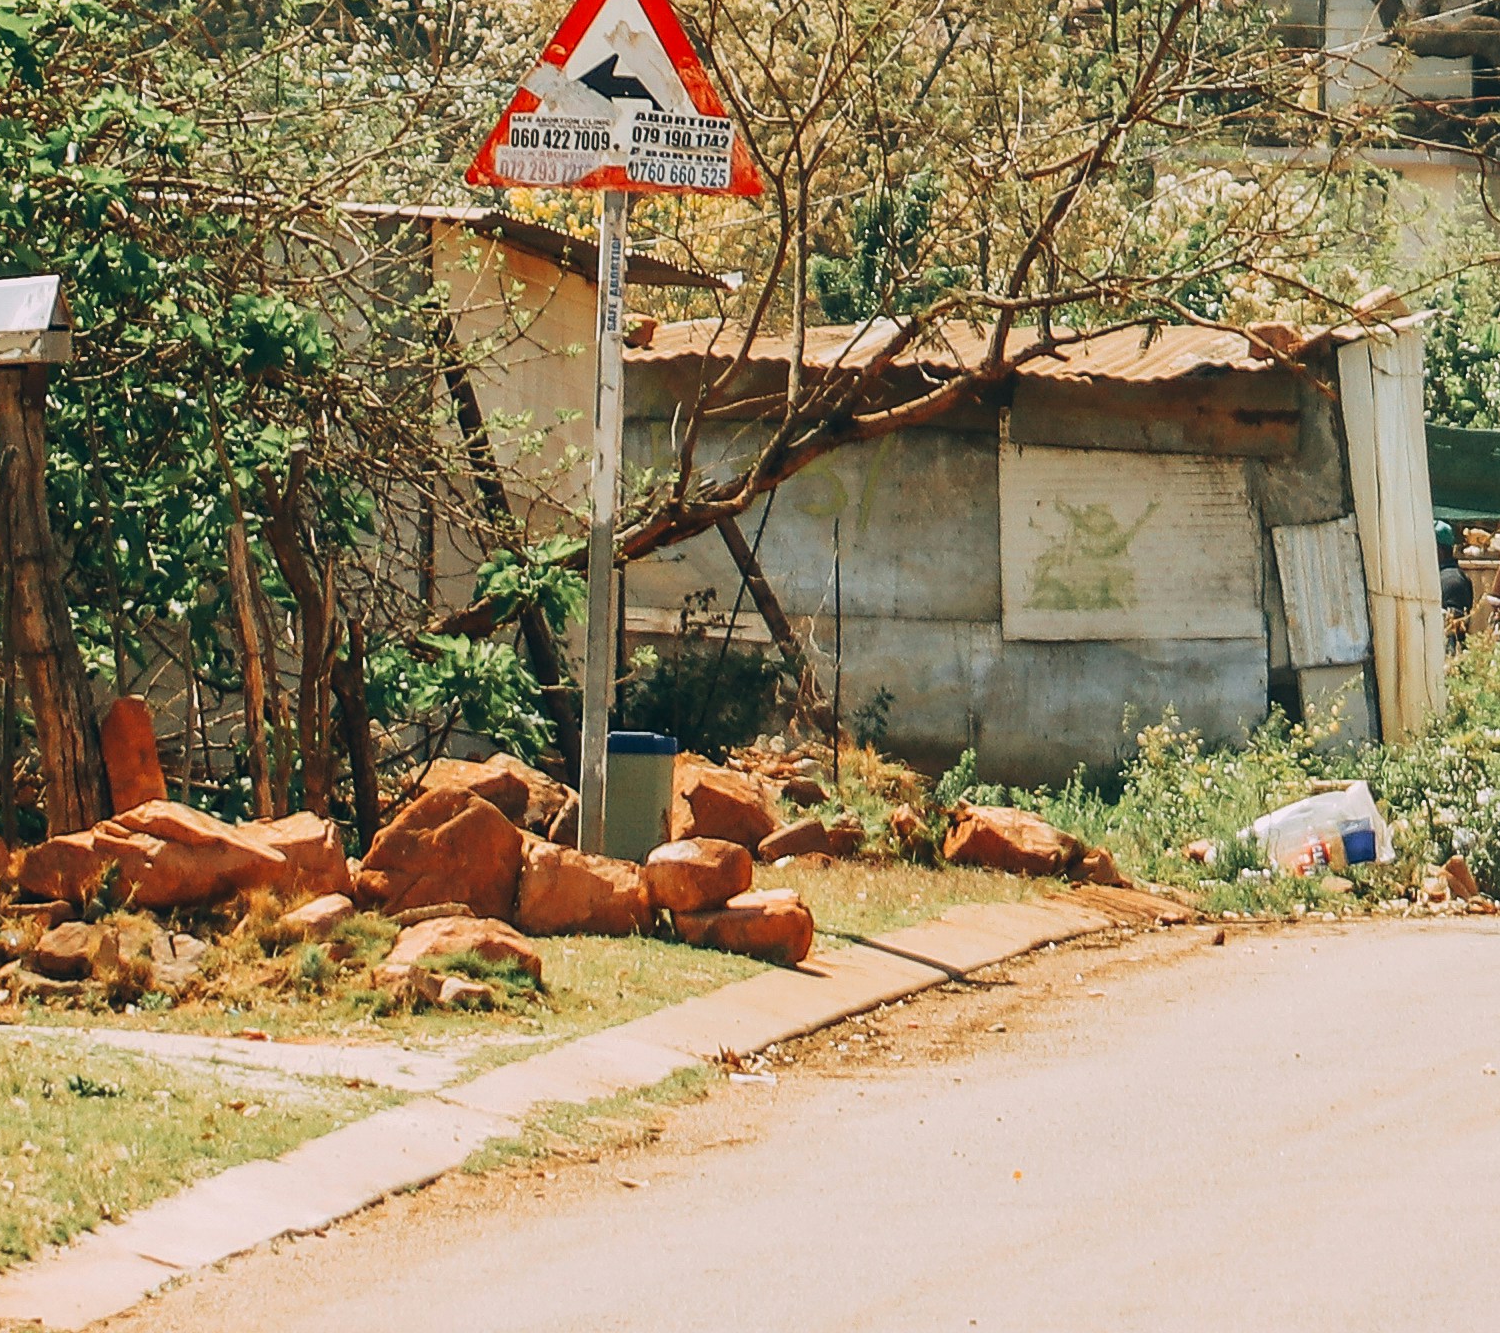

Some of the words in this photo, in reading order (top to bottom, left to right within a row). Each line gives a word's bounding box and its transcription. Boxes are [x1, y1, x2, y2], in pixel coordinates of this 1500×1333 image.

[635, 112, 731, 130] ABORTION
[511, 128, 539, 148] 060
[543, 129, 570, 150] 422
[574, 130, 610, 151] 7009
[632, 126, 660, 143] 079
[664, 130, 692, 148] 190
[696, 133, 729, 149] 1742
[530, 161, 558, 183] 293
[628, 160, 665, 183] 0760
[670, 164, 696, 185] 660
[700, 167, 727, 187] 525
